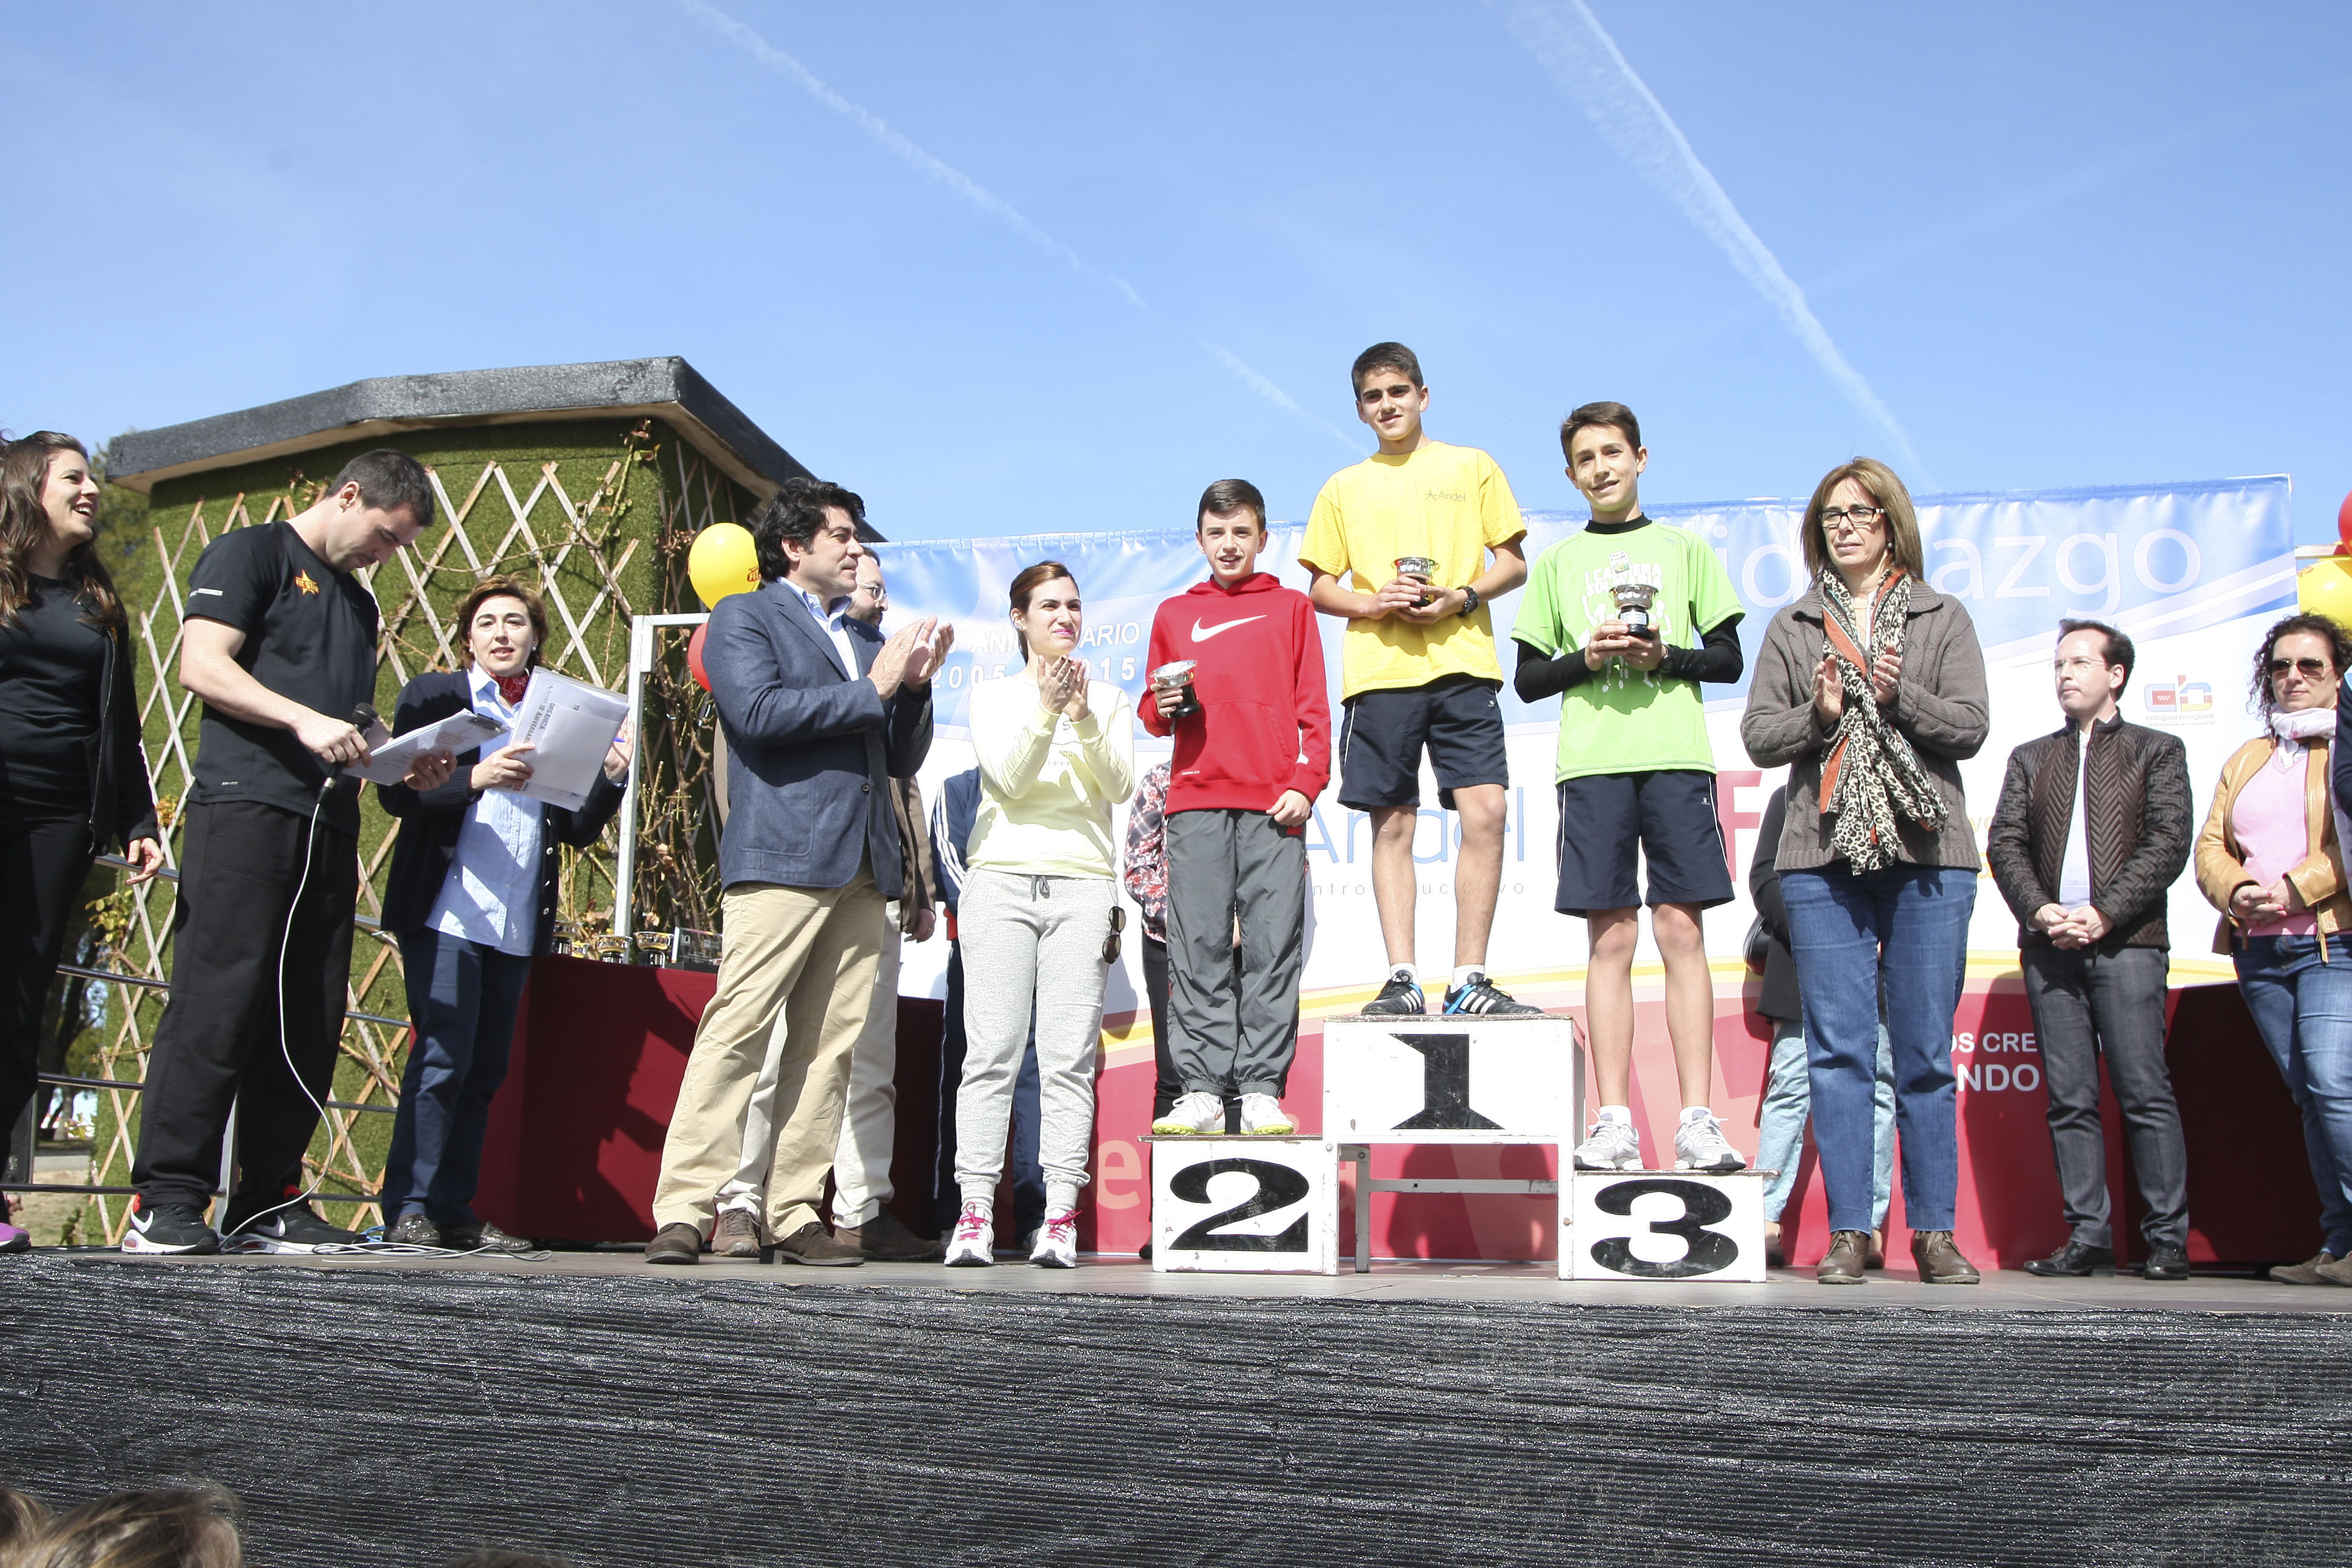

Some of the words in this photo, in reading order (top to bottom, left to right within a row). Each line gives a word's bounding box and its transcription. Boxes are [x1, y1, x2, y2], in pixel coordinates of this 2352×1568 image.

[1683, 521, 2201, 619] idazgo
[970, 621, 1141, 654] ANIARIO
[1312, 882, 1365, 896] ntro
[1388, 1033, 1505, 1130] 1
[1956, 1063, 2040, 1092] NDO
[1169, 1158, 1310, 1252] 2
[1590, 1179, 1739, 1278] 3
